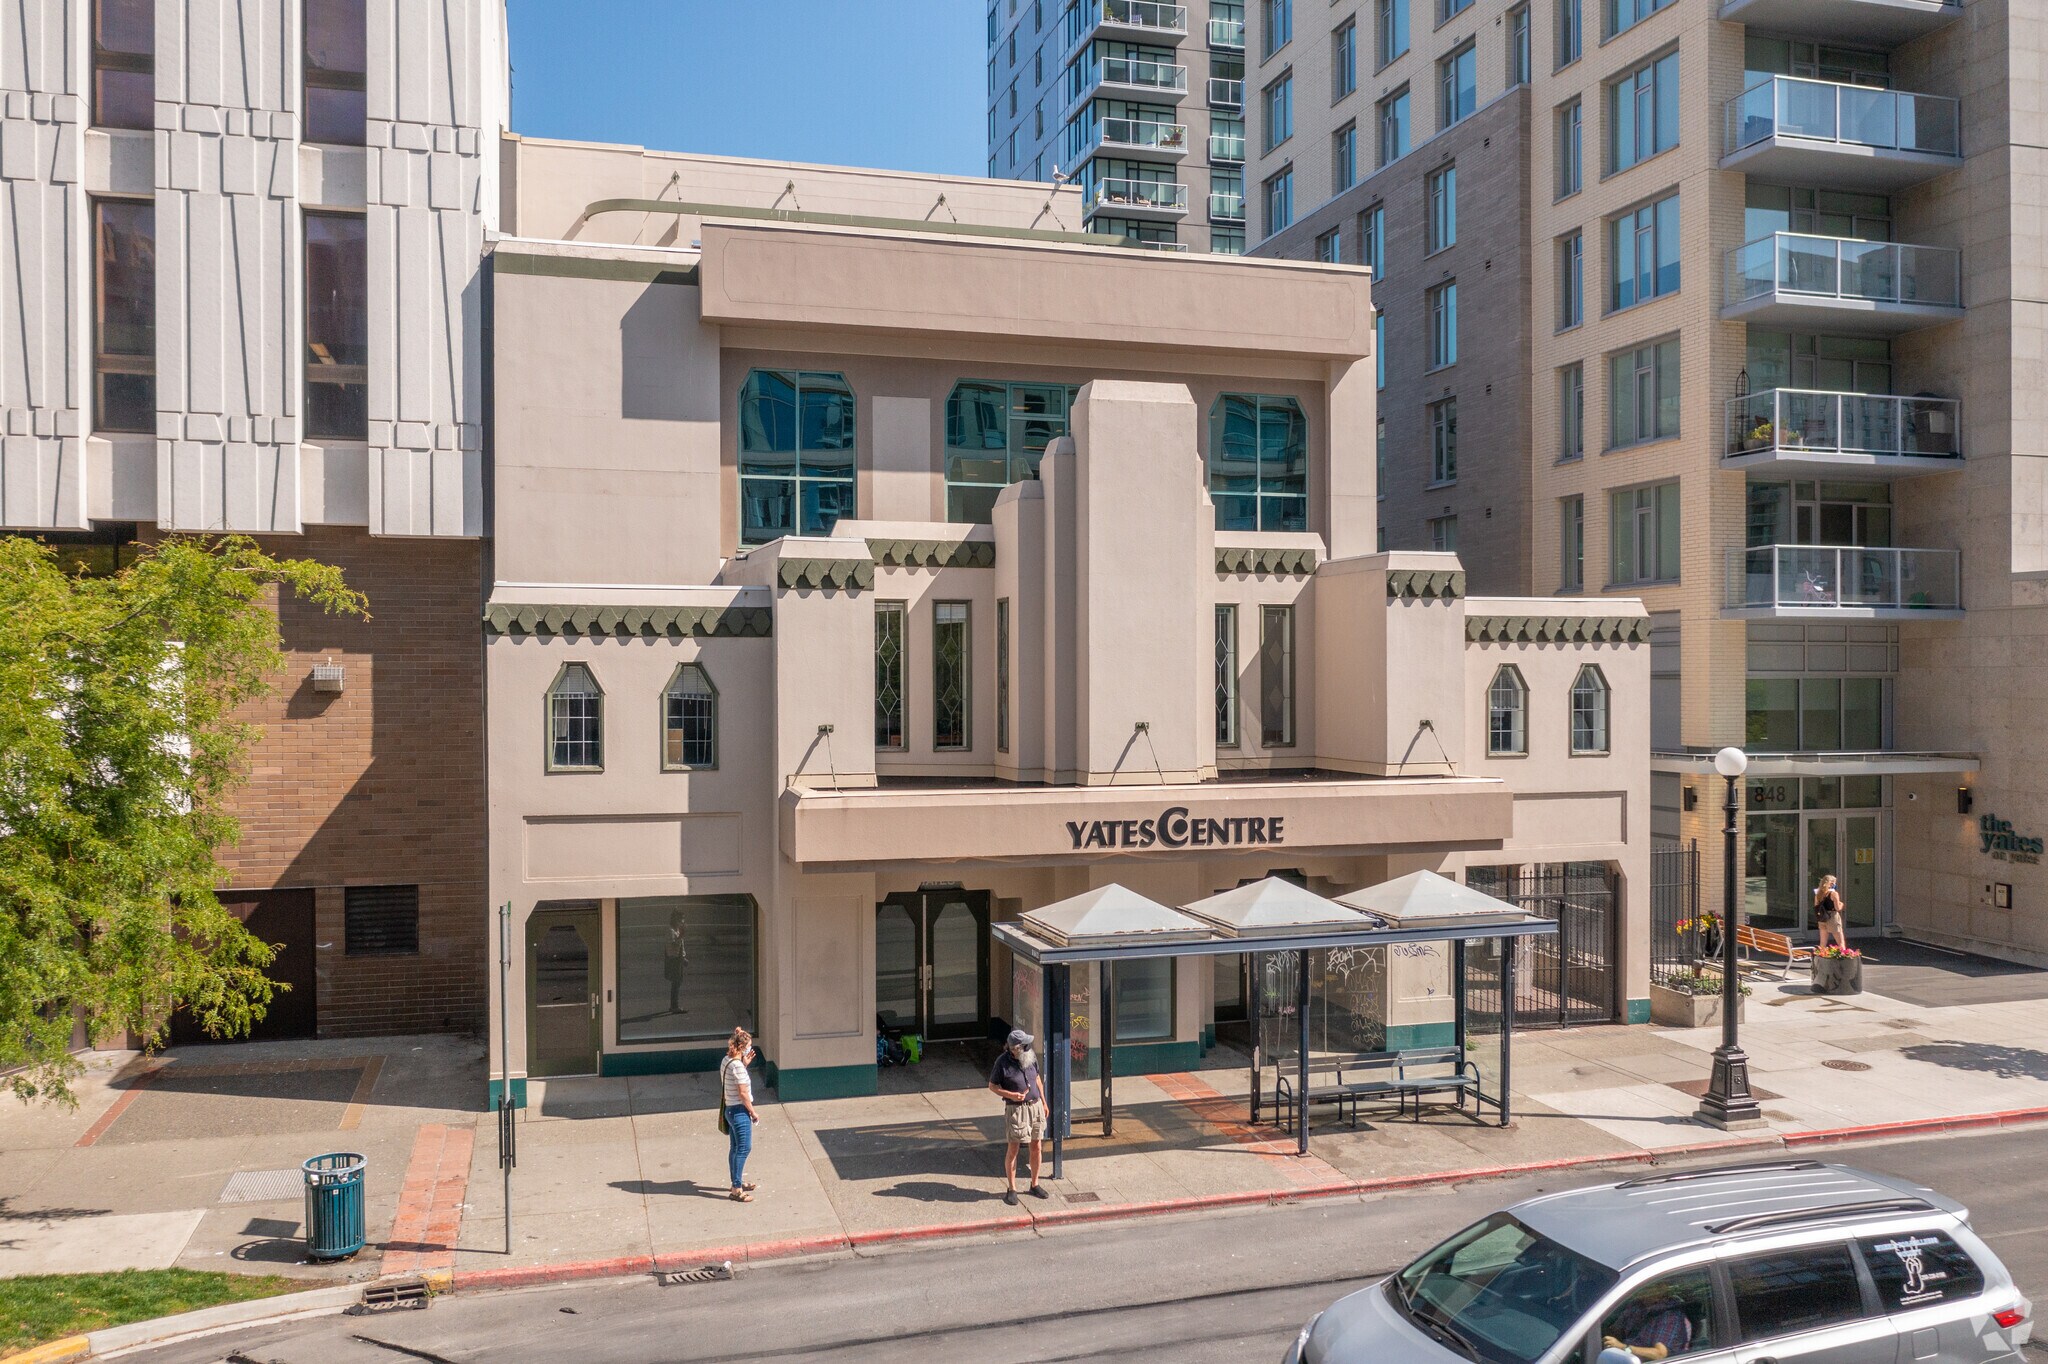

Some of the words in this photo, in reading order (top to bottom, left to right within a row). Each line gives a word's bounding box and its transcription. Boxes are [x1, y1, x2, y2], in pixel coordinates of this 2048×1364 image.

[1755, 786, 1785, 802] 848
[1979, 813, 2012, 832] the
[1979, 830, 2044, 854] yates
